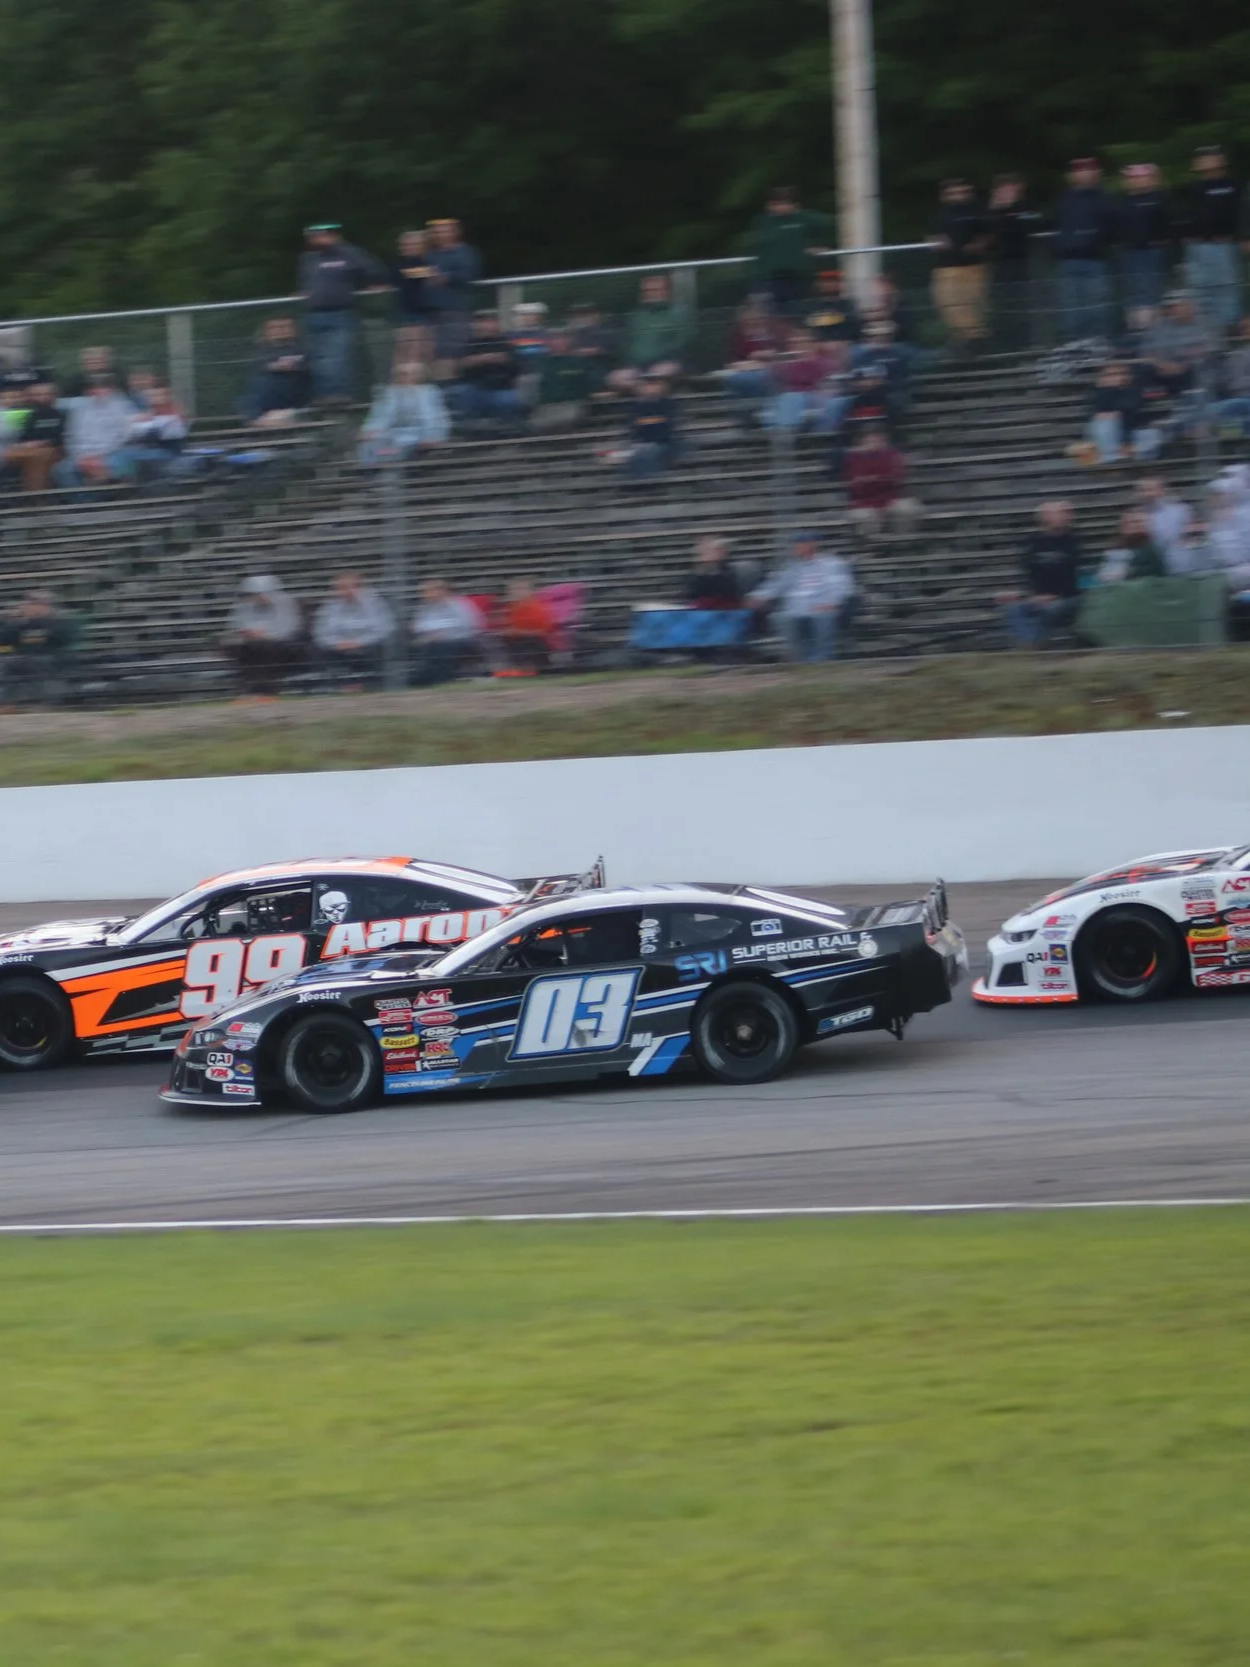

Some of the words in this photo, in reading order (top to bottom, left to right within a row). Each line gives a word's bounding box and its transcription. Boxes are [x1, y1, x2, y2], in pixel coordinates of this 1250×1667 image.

[732, 939, 814, 960] SUPERIOR
[817, 934, 858, 949] RAIL
[1026, 951, 1049, 963] QA1
[177, 932, 307, 1018] 99
[674, 951, 729, 981] SRI
[295, 990, 342, 1003] Hoosier
[516, 973, 635, 1054] 03
[209, 1054, 232, 1064] QA1
